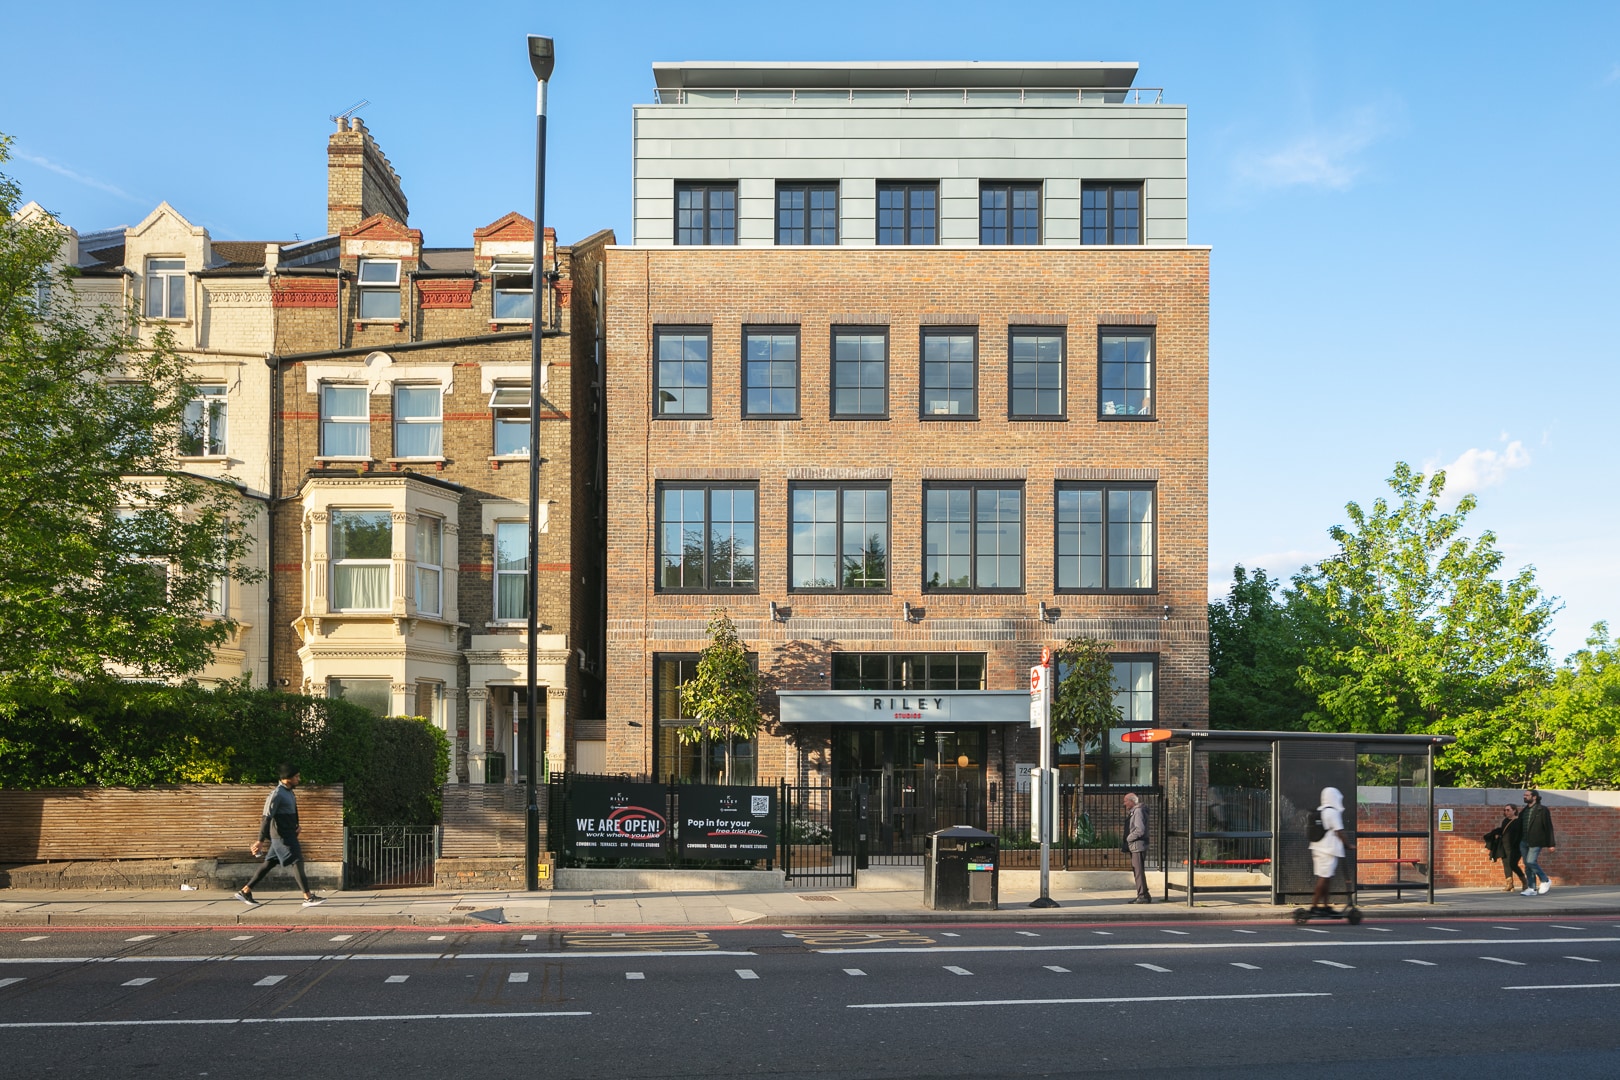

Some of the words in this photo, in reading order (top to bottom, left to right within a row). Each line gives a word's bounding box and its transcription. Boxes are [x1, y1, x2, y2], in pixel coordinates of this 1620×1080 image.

[1042, 648, 1047, 661] S
[874, 698, 942, 710] RILEY
[577, 819, 594, 831] WE
[598, 819, 620, 831] ARE
[625, 820, 660, 832] OPEN!
[688, 819, 704, 828] Pop
